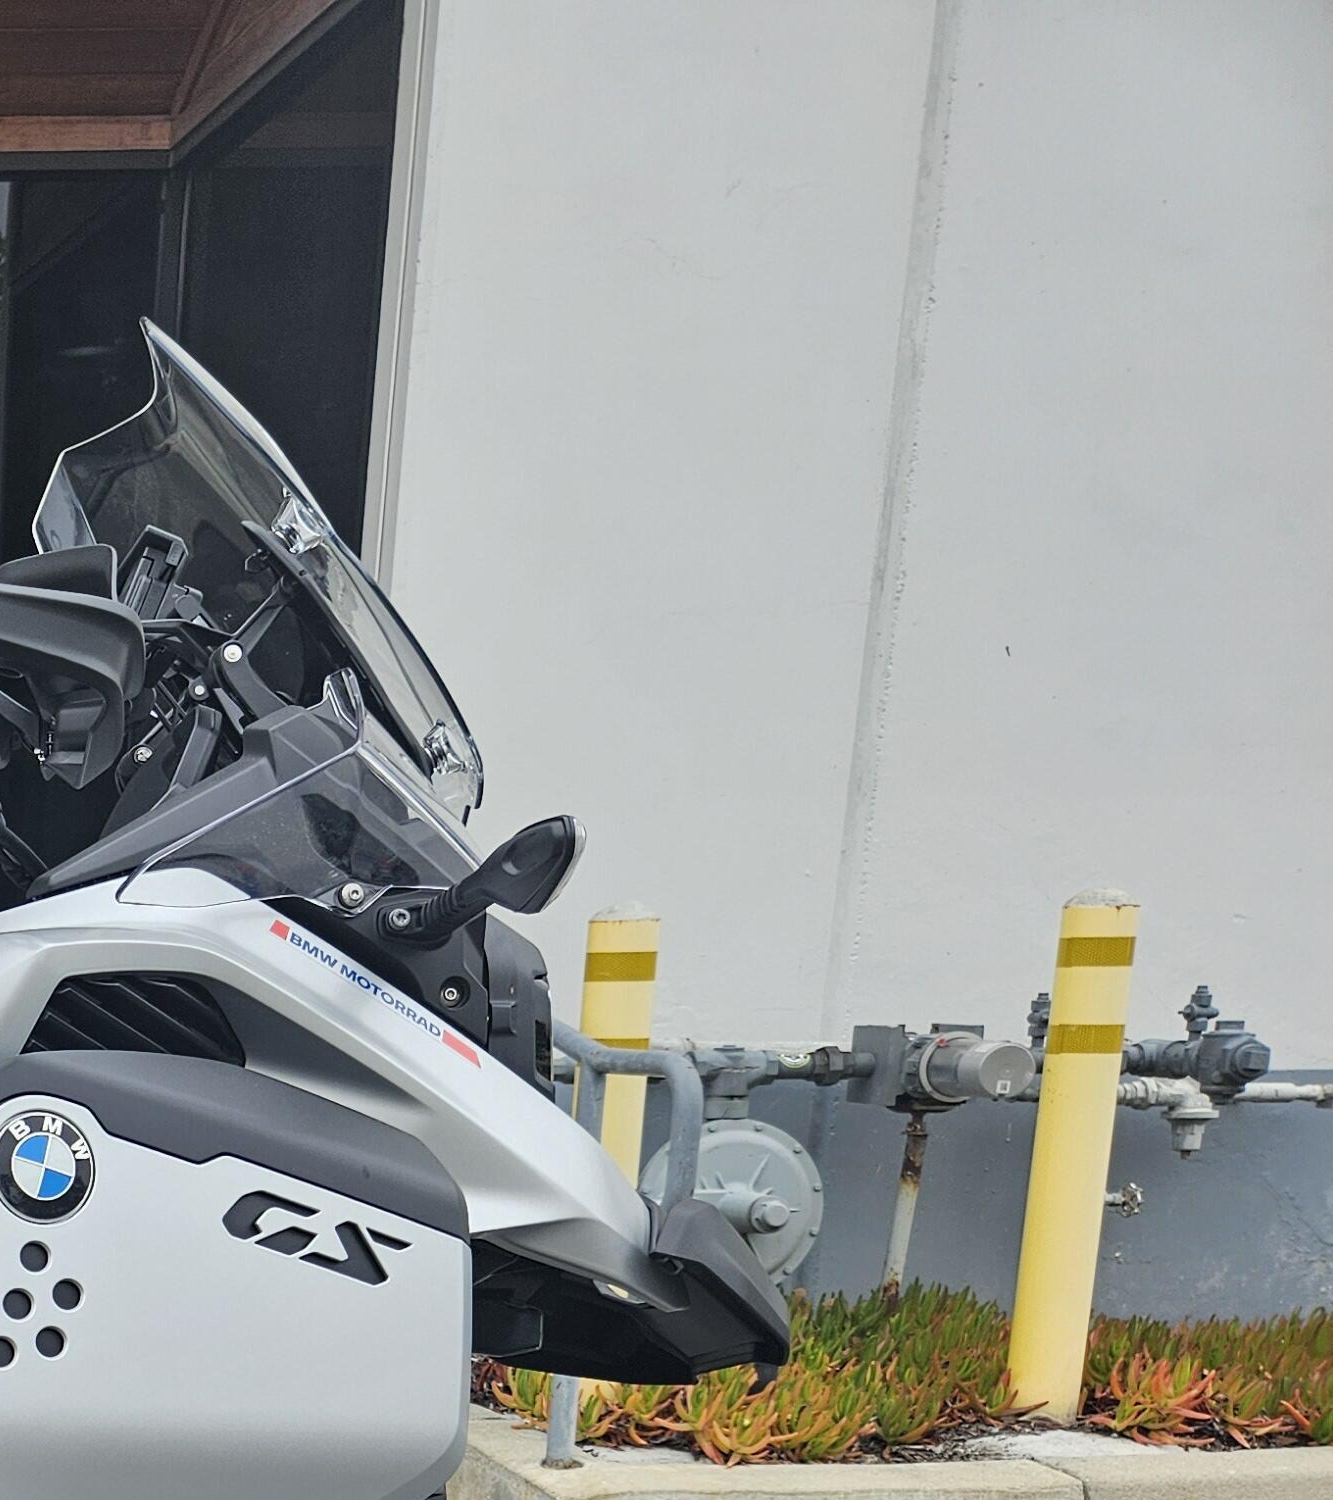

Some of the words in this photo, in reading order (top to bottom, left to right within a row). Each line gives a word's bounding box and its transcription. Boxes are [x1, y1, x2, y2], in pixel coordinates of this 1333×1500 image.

[288, 931, 339, 970] BMW
[338, 964, 442, 1038] MOTORRAD
[9, 1115, 91, 1161] BMW
[222, 1189, 414, 1287] GS
